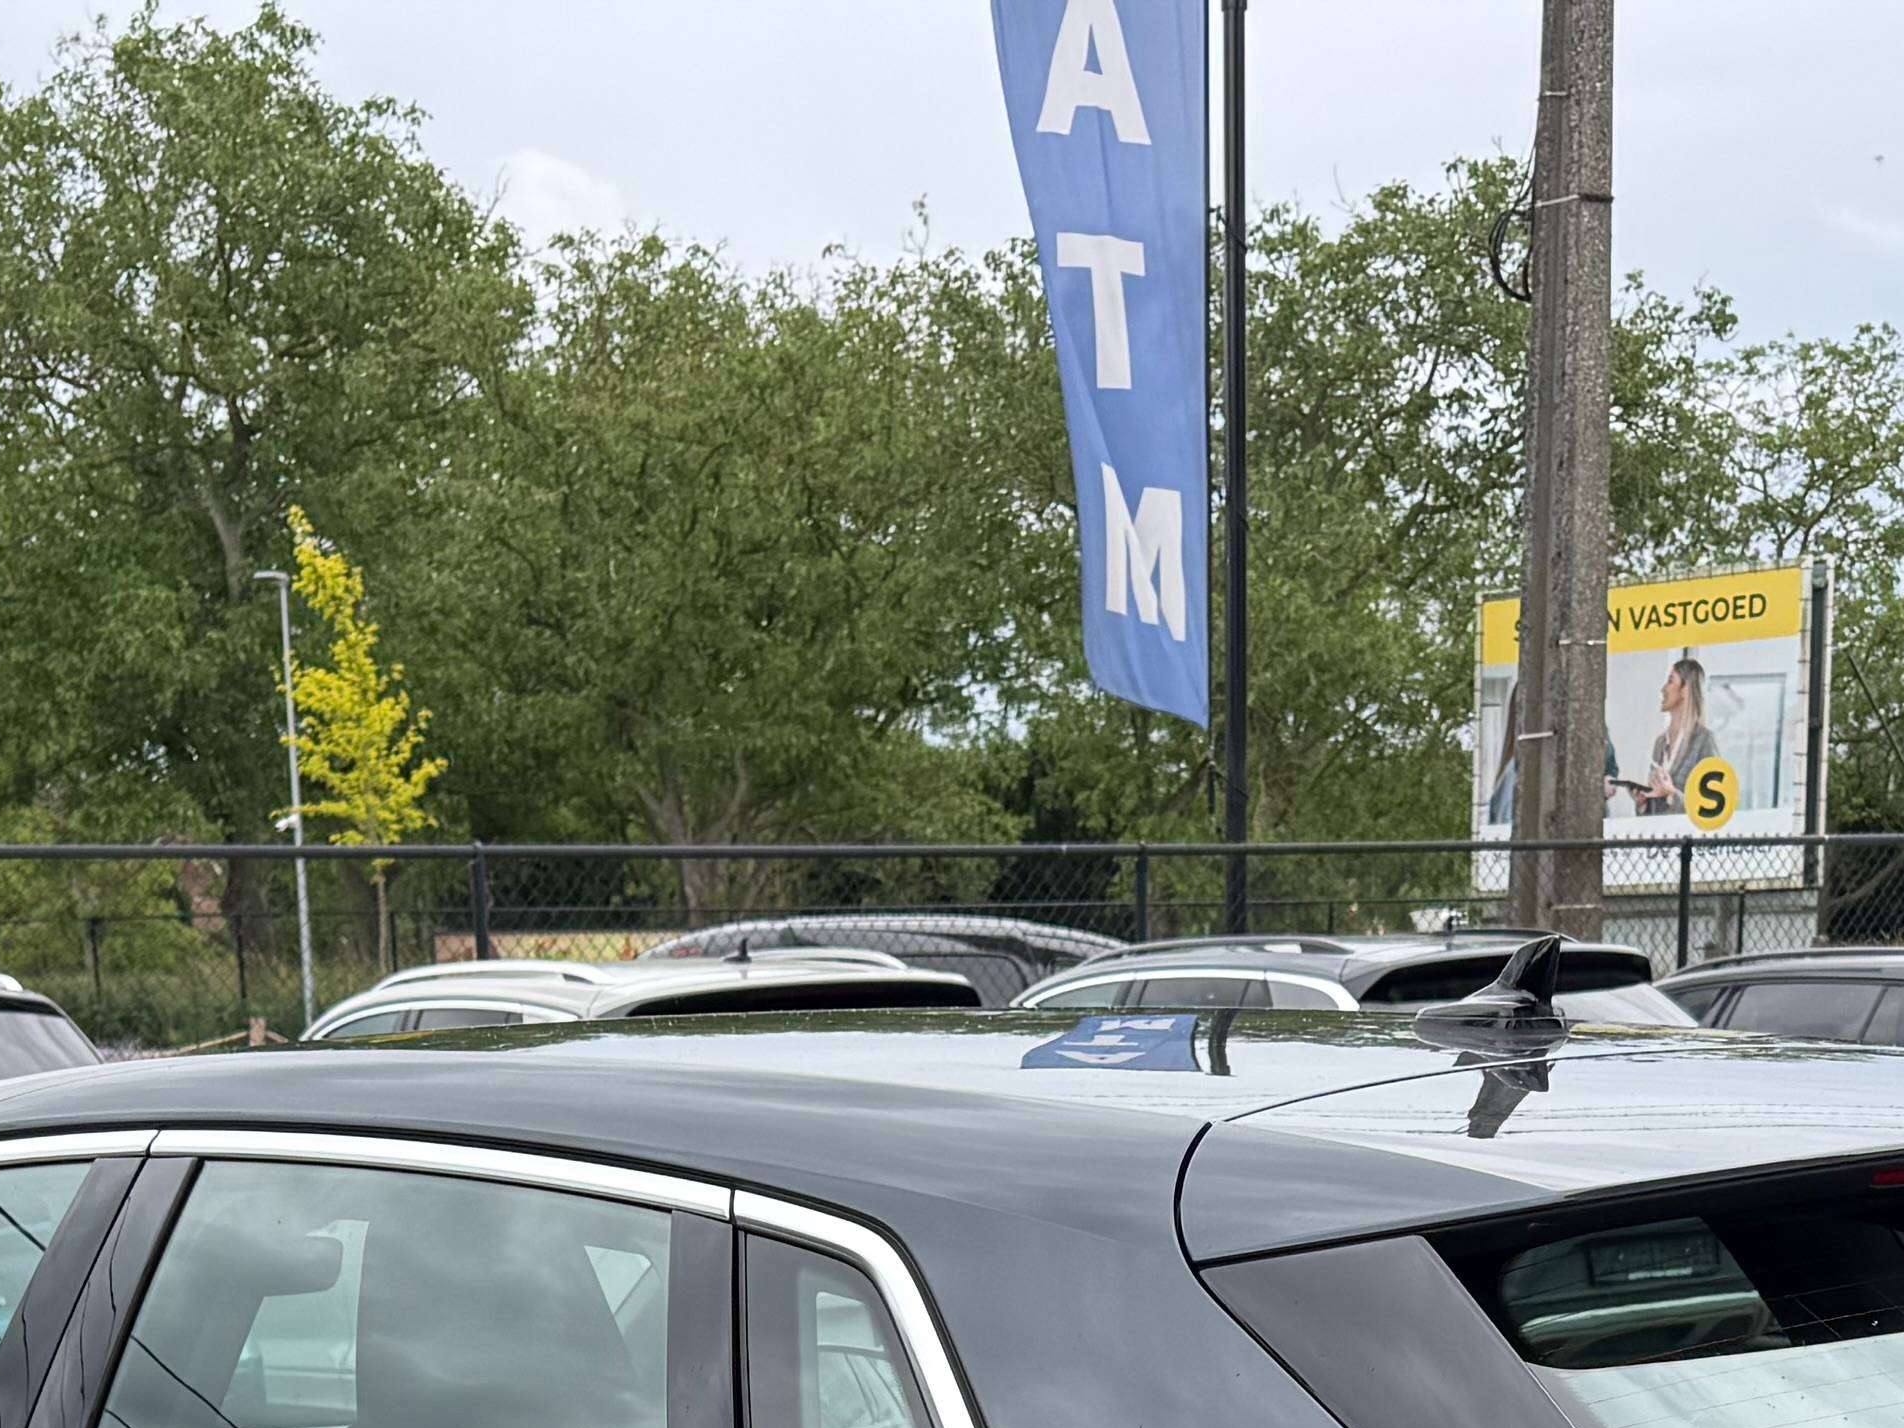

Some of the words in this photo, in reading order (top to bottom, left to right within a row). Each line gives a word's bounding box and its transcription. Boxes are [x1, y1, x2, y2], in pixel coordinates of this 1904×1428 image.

[1036, 0, 1186, 642] ATM
[1630, 592, 1767, 631] VASTGOED
[1697, 770, 1727, 819] S
